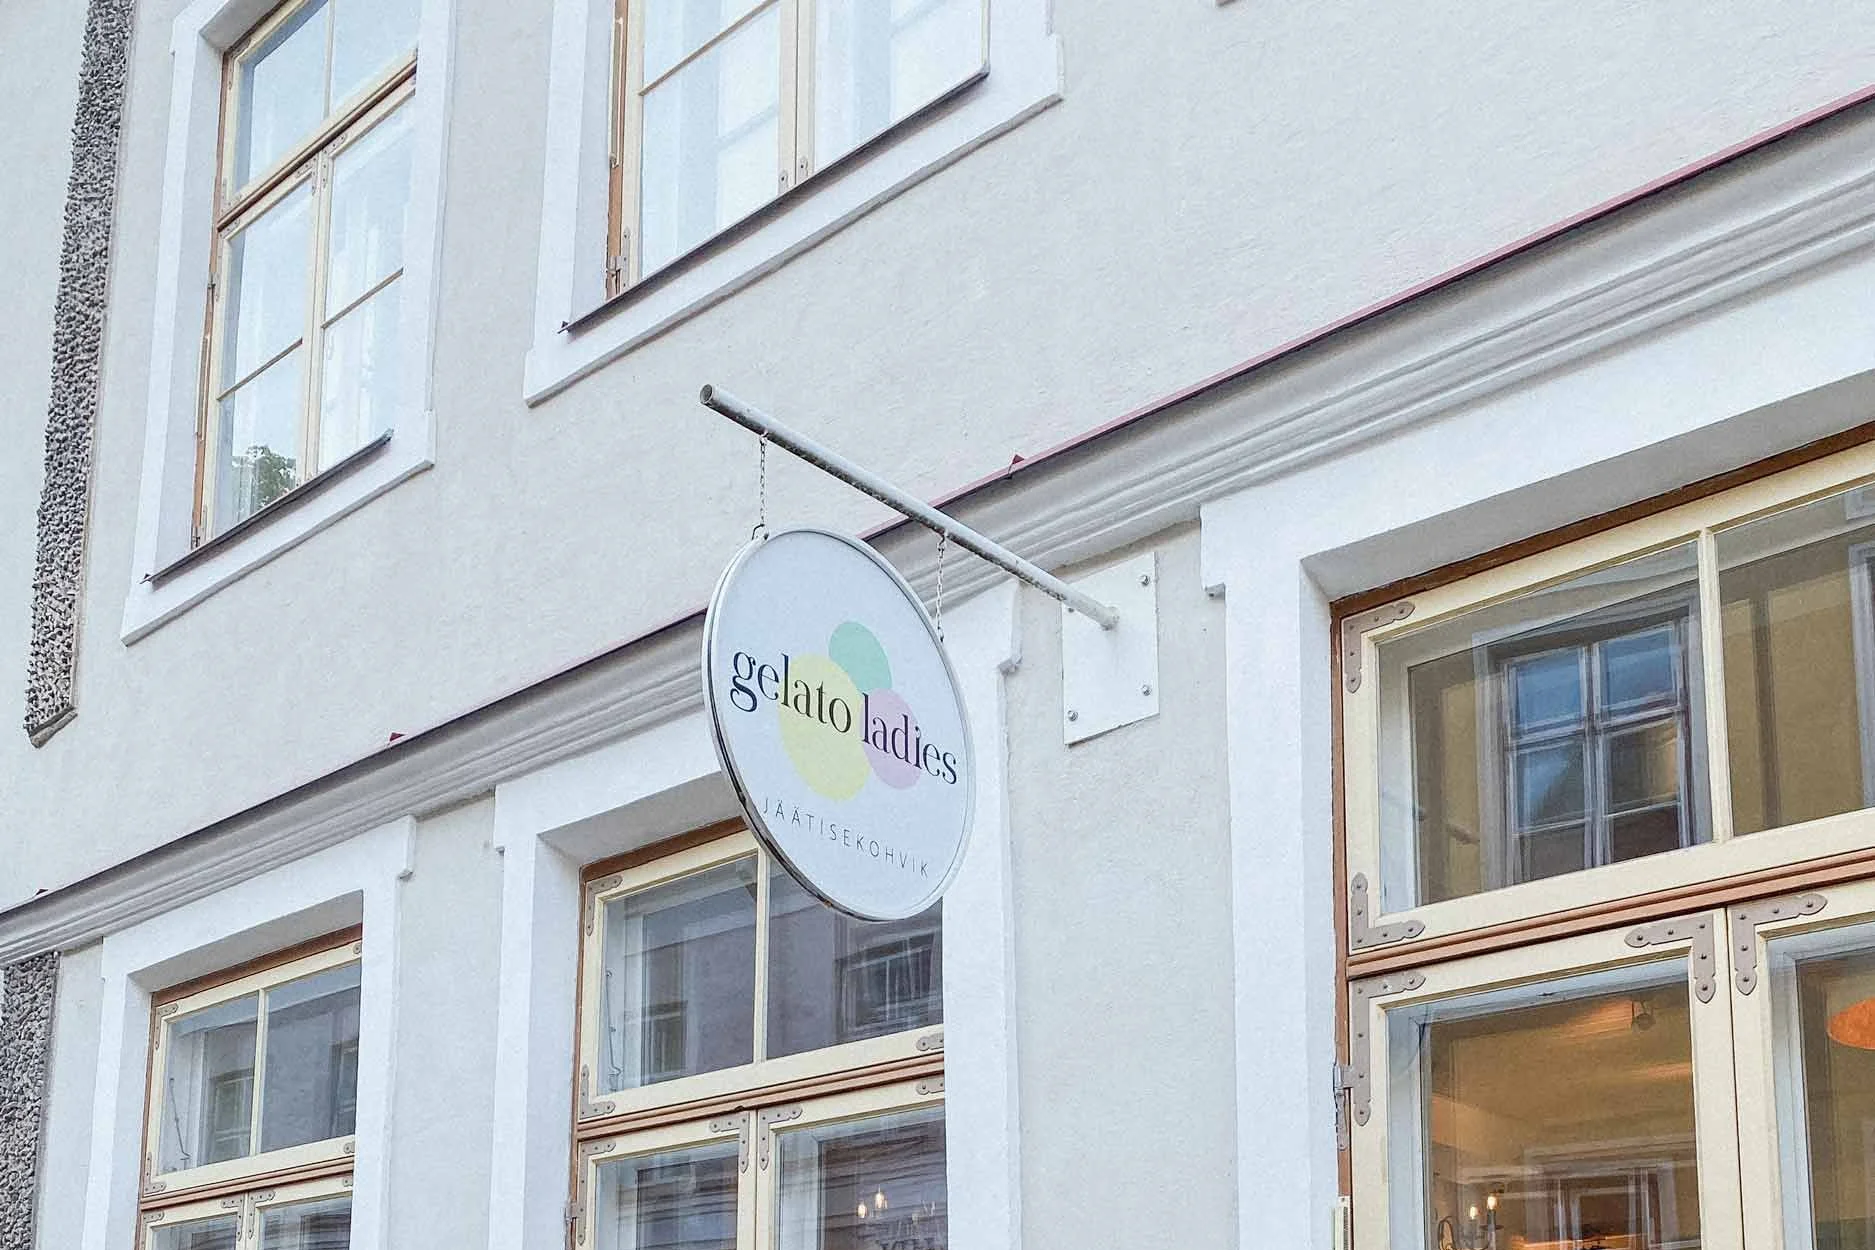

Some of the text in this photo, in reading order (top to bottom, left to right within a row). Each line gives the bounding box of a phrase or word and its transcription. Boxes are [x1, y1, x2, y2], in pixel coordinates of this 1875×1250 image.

[729, 650, 958, 785] gelato ladies
[762, 797, 929, 878] JÄÄTISEKOHVIK
